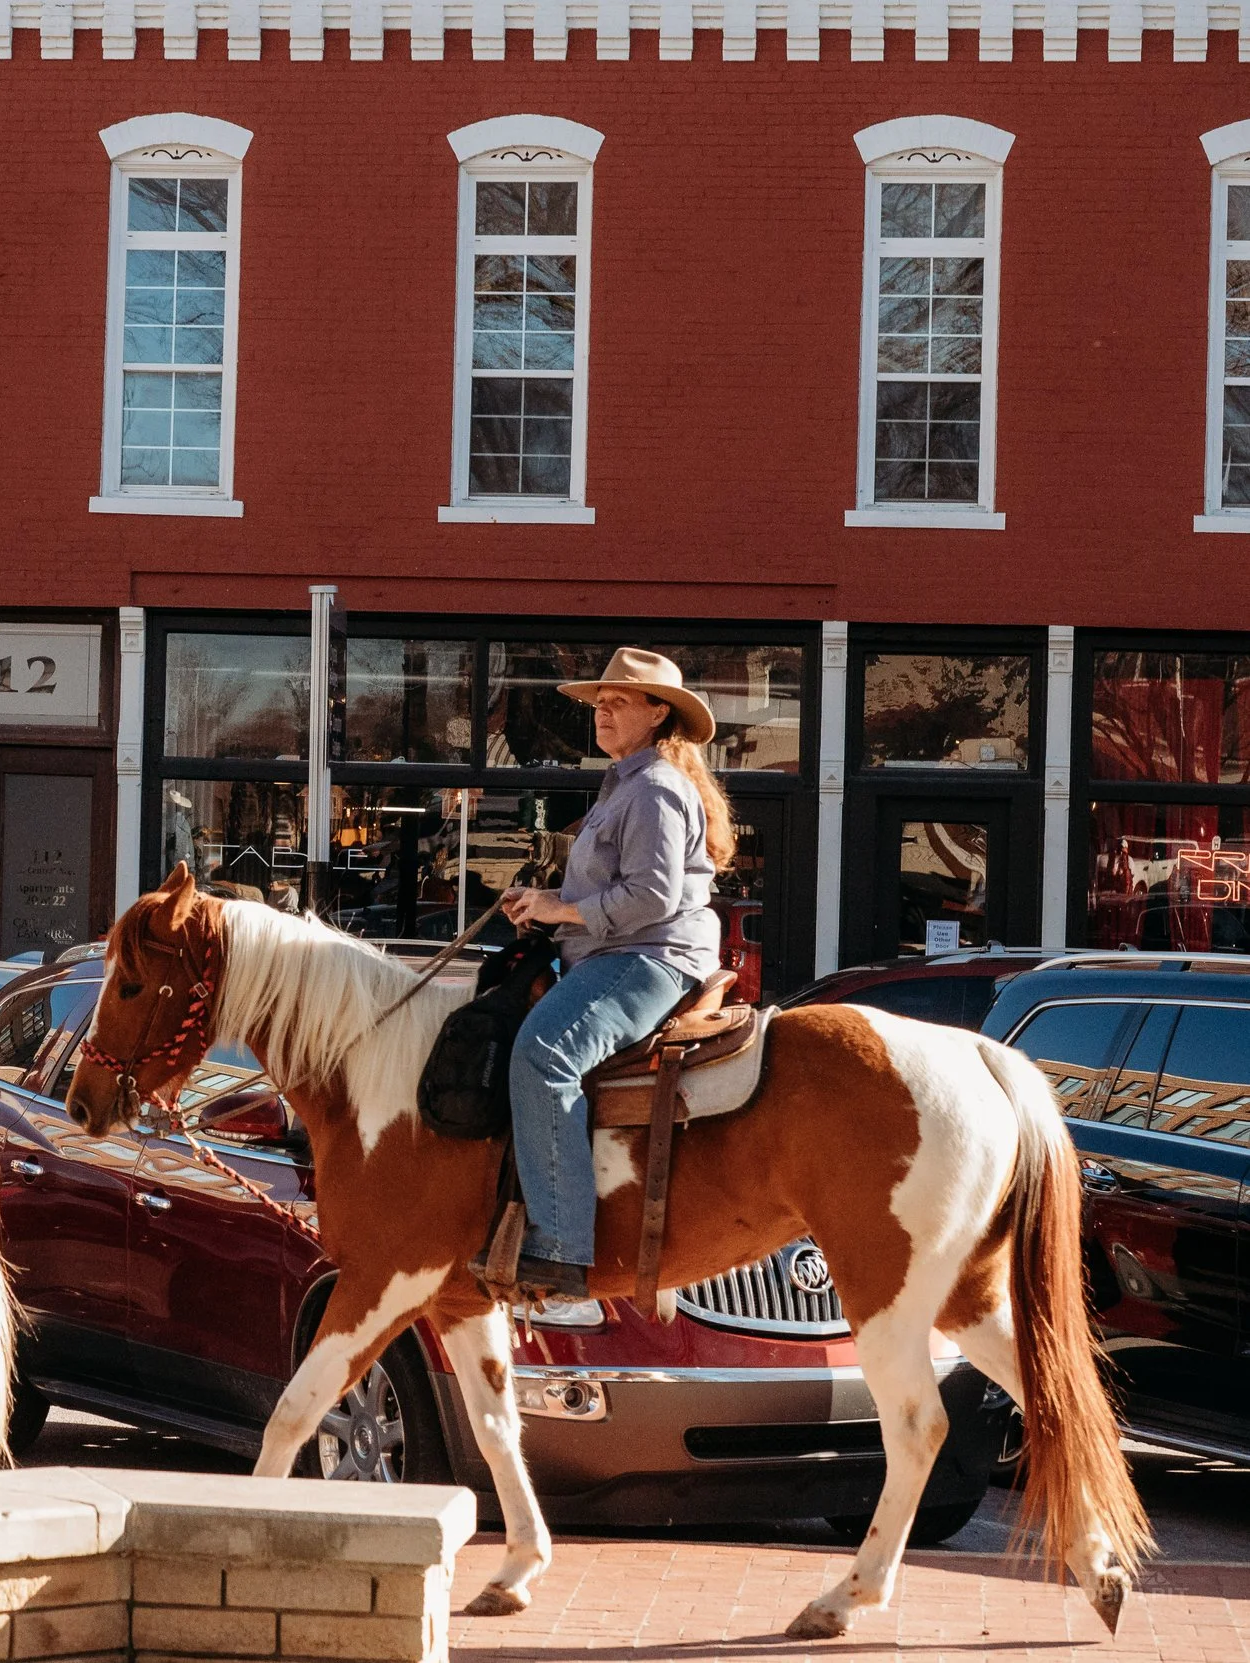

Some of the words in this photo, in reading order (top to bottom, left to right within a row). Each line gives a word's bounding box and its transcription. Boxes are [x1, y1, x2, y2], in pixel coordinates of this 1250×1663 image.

[32, 850, 62, 864] 112
[203, 844, 387, 871] TABE
[52, 895, 66, 906] 22
